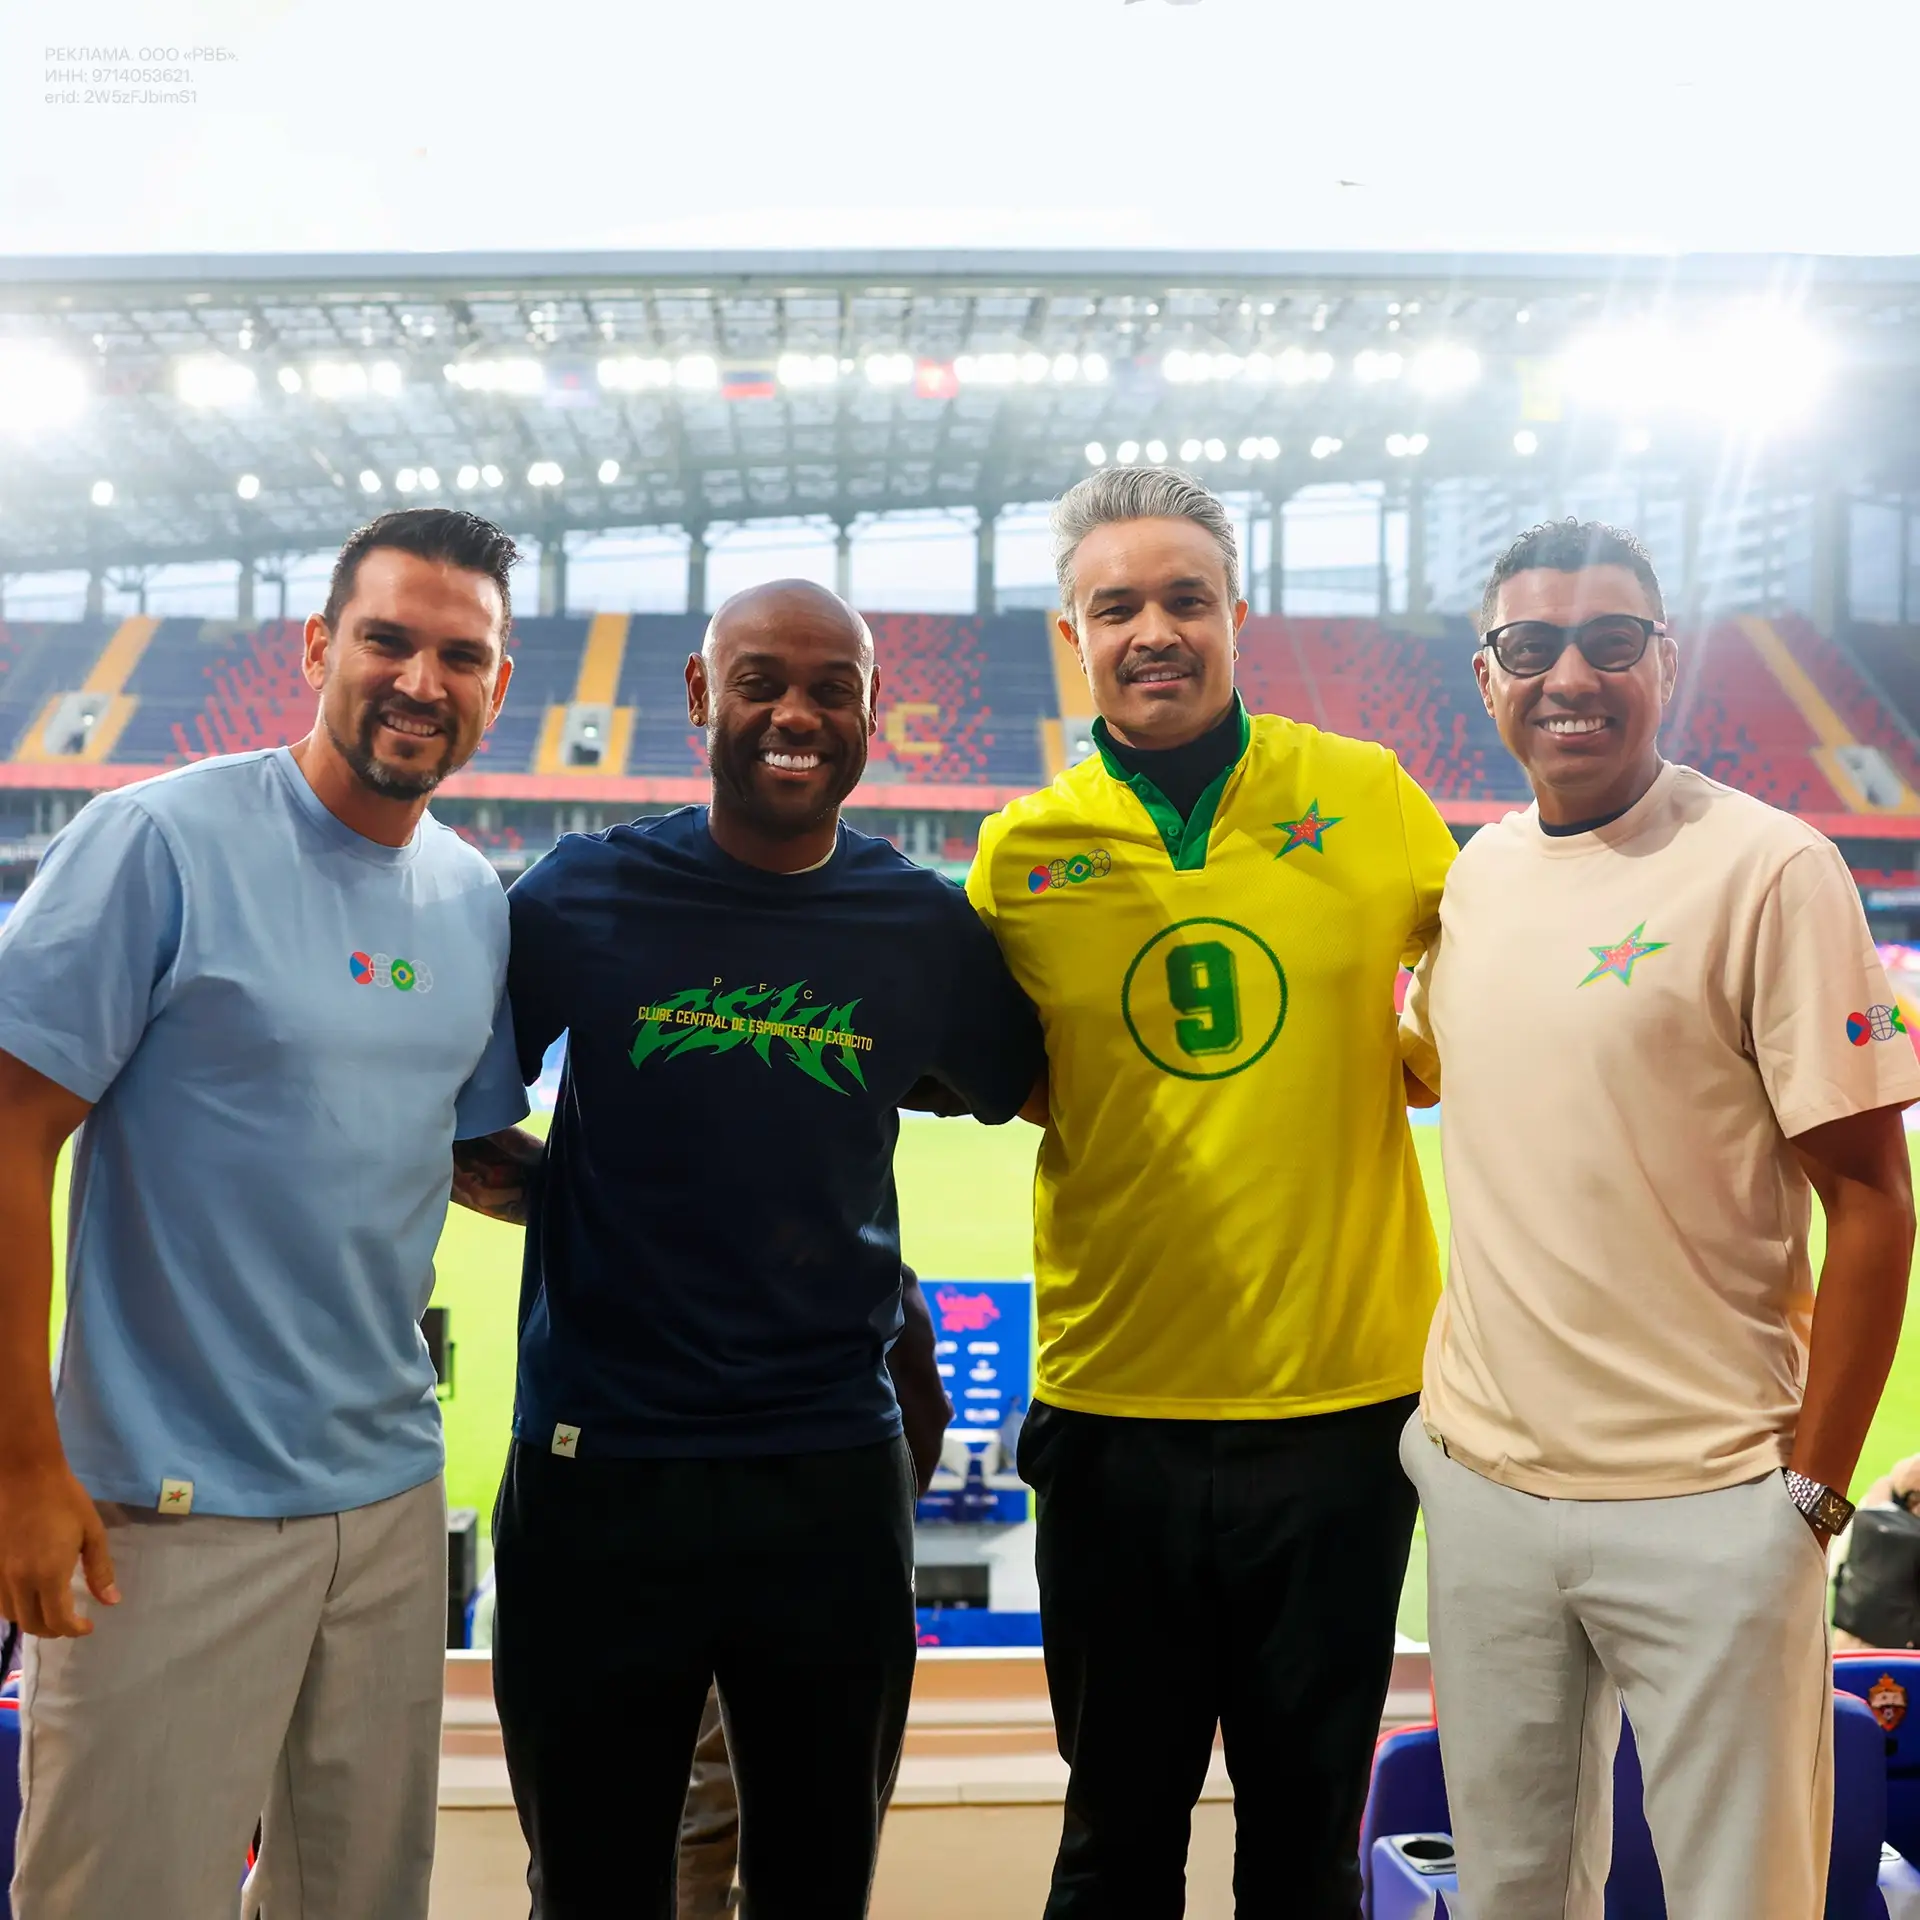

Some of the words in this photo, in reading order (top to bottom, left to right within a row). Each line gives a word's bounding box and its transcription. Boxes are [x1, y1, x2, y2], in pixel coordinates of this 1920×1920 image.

[713, 976, 722, 987] P
[758, 983, 767, 993] F
[803, 989, 813, 1000] C
[1165, 941, 1243, 1057] 9
[638, 1006, 673, 1023] CLUBE
[676, 1011, 728, 1030] CENTRAL
[731, 1018, 745, 1032] DE
[749, 1019, 806, 1039] ESPORTES
[808, 1027, 823, 1042] DO
[825, 1028, 873, 1051] EXÉRCITO
